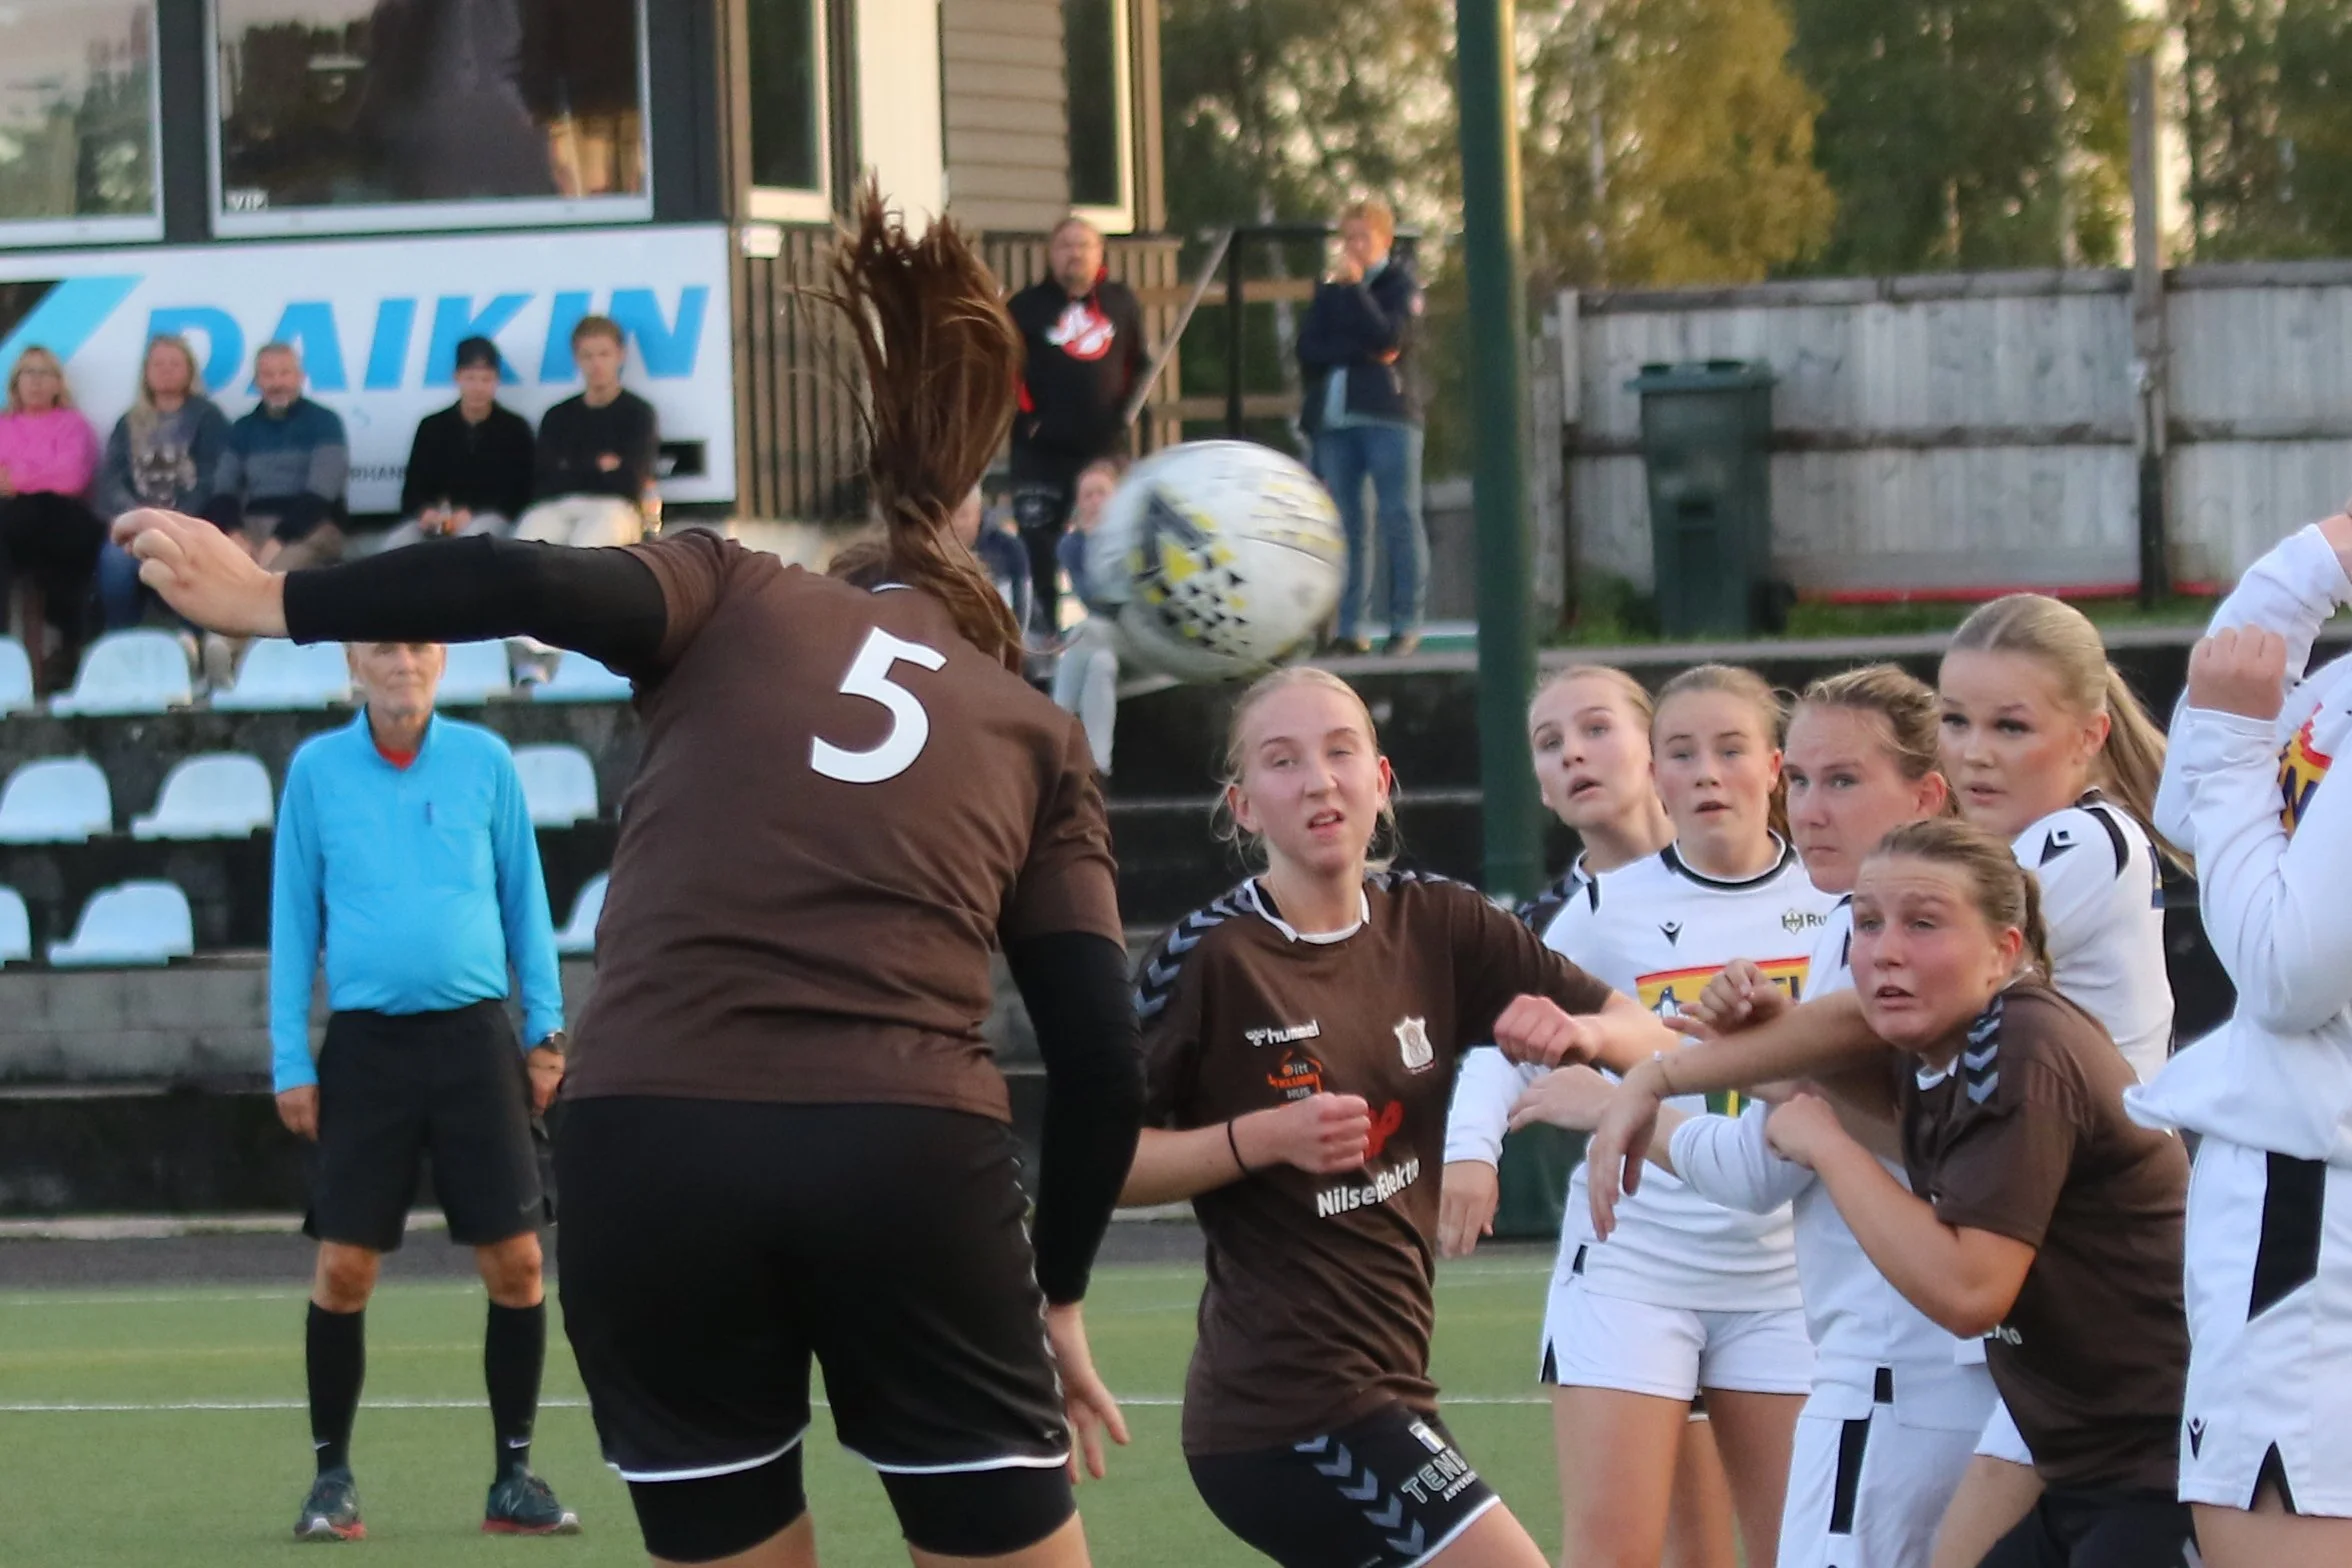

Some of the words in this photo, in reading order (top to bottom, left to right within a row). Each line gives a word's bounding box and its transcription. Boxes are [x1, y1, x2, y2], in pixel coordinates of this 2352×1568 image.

[145, 284, 711, 396] DAIKIN
[811, 625, 947, 784] 5
[1266, 1019, 1320, 1044] hummel
